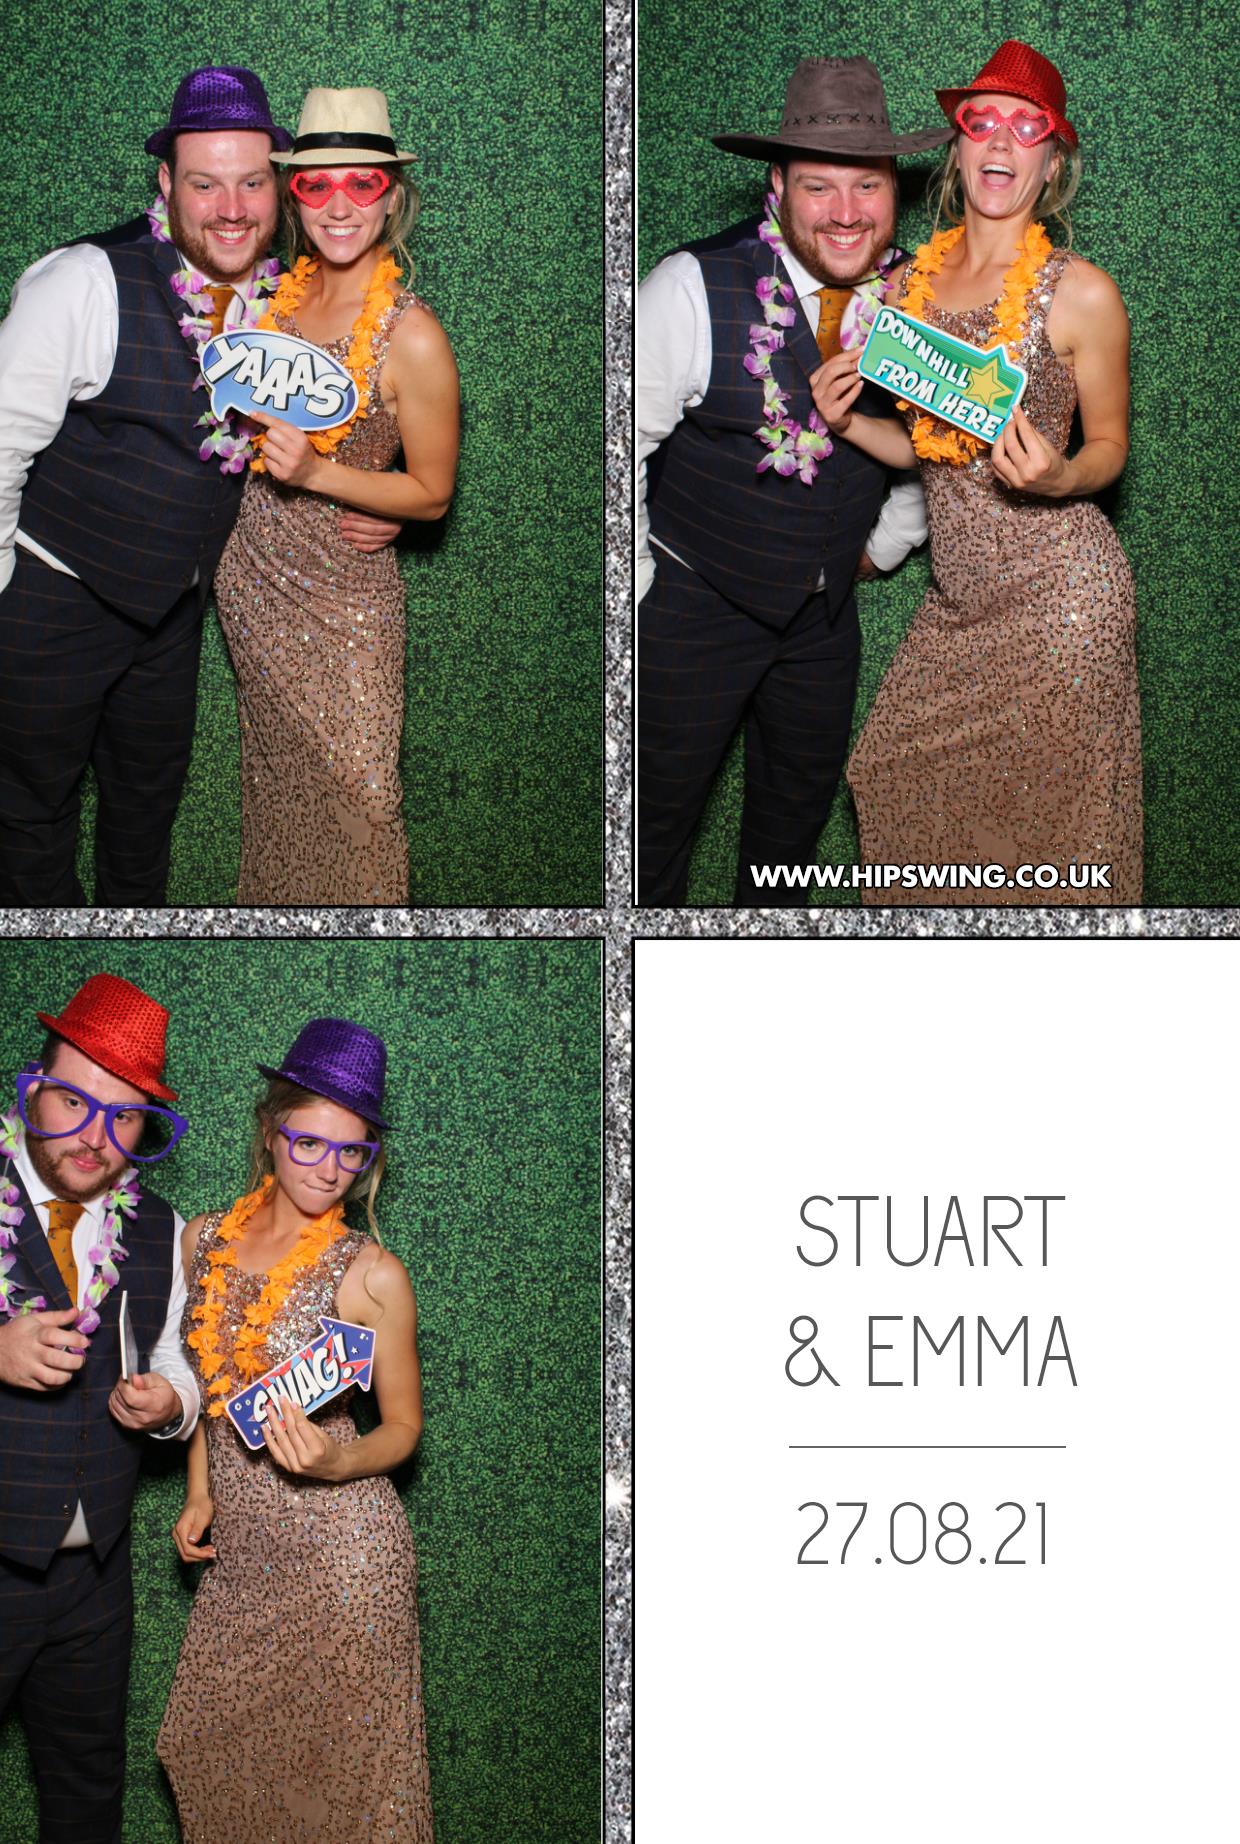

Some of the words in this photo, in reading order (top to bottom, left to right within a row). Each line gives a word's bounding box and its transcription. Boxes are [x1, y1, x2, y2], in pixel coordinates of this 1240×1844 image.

[204, 337, 354, 418] YAAAS
[876, 310, 970, 389] DOWNHILL
[874, 358, 939, 404] FROM
[937, 393, 1005, 438] HERE
